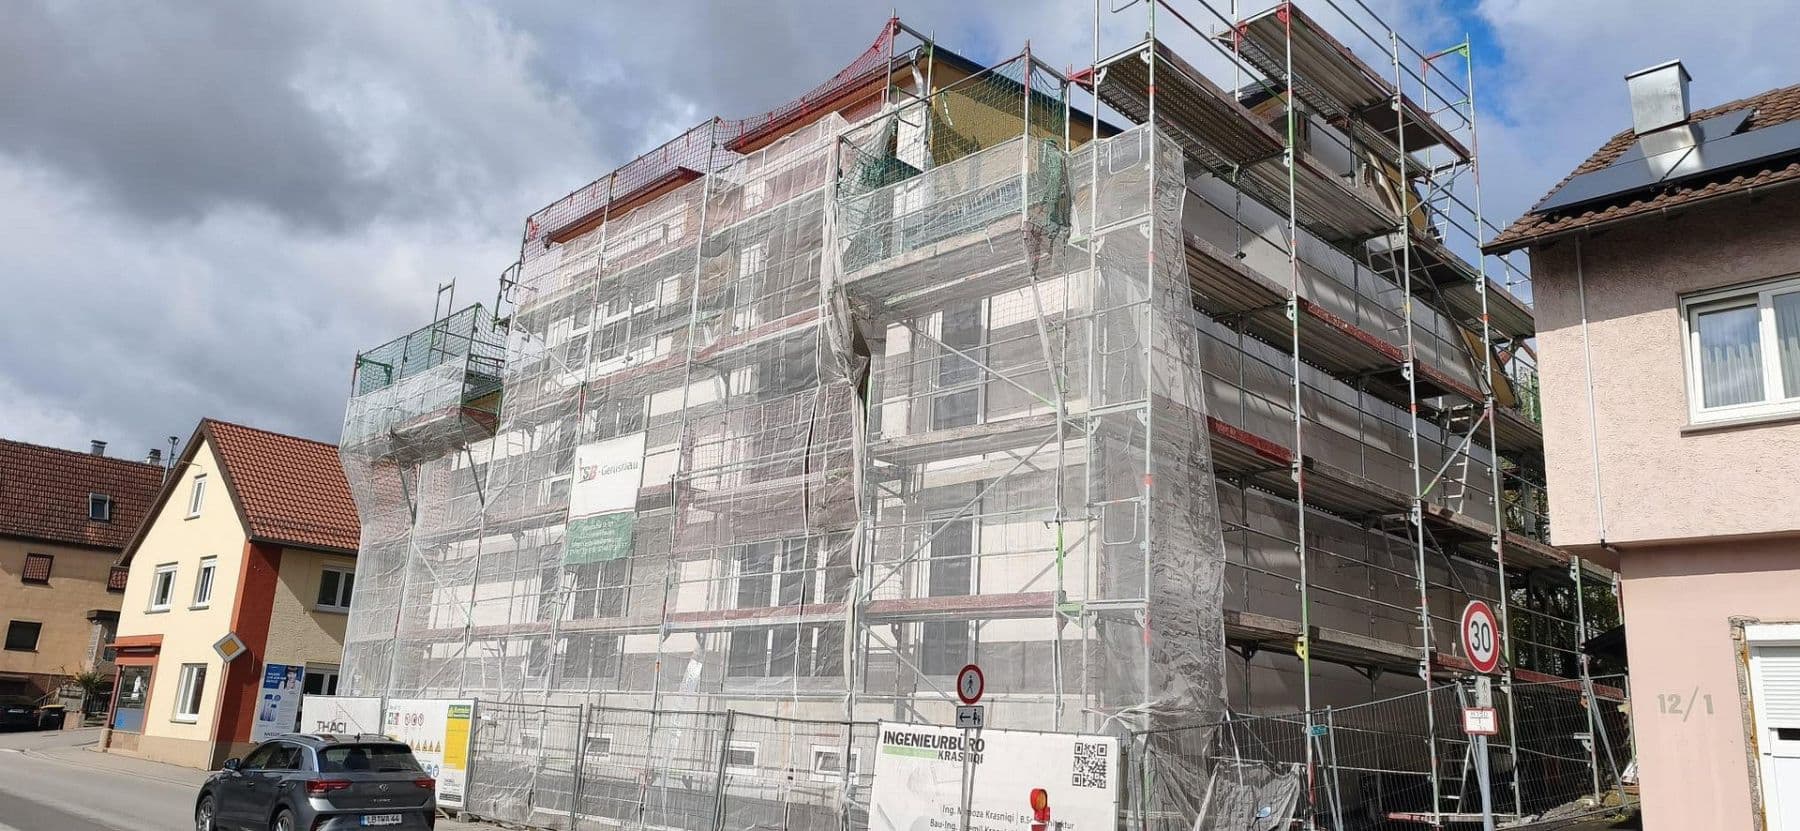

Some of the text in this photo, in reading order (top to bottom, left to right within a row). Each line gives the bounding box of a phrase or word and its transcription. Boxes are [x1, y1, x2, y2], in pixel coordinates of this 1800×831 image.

[1471, 620, 1491, 653] 30
[1658, 686, 1714, 722] 12/1
[985, 810, 1015, 824] Krasniqi
